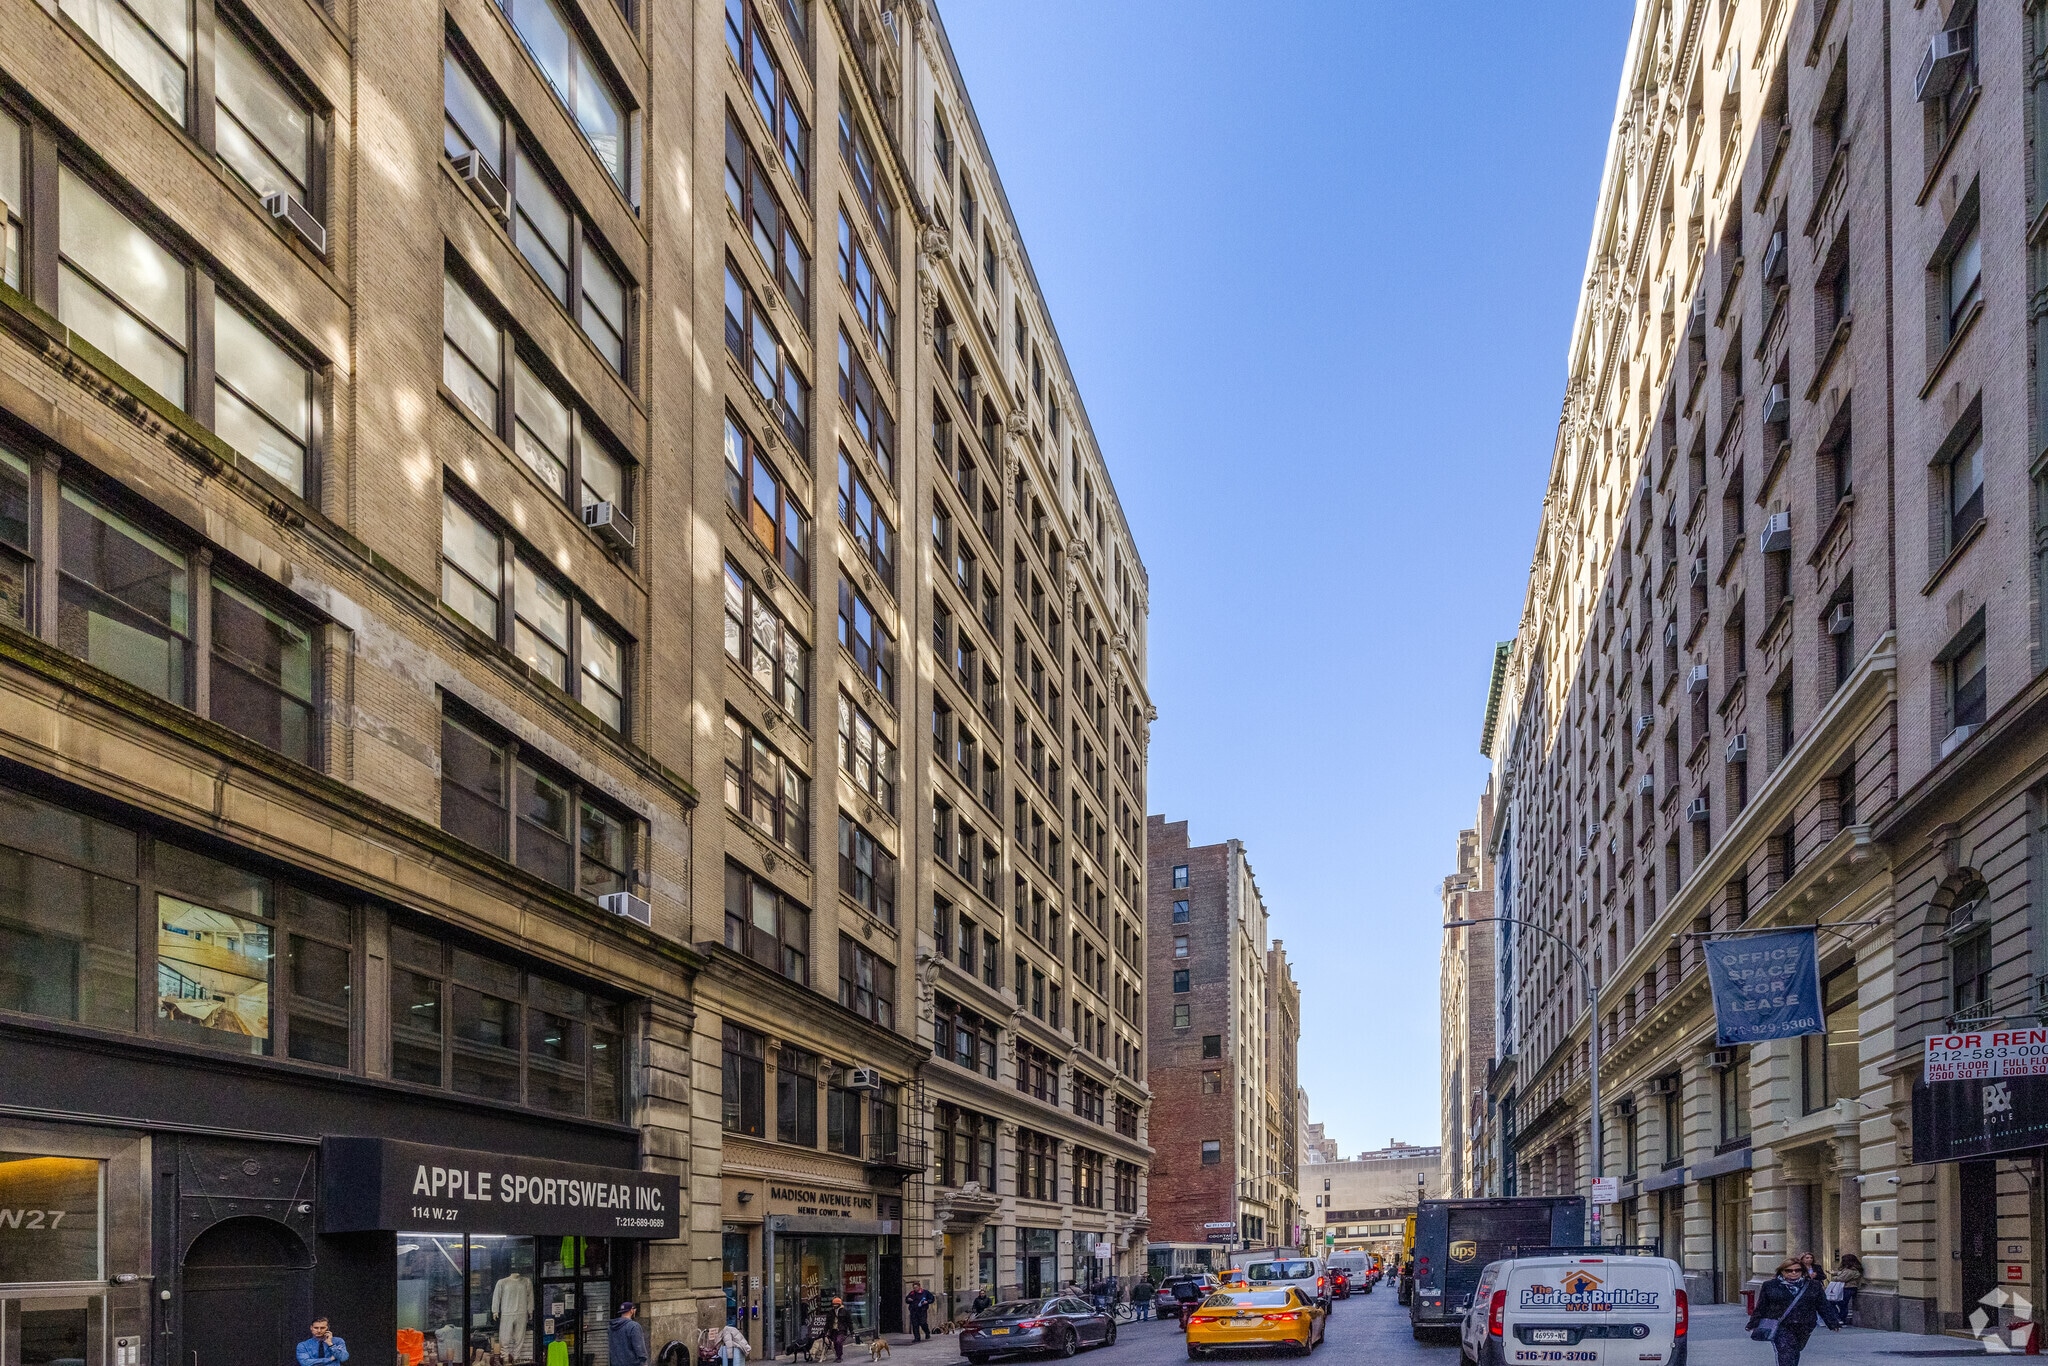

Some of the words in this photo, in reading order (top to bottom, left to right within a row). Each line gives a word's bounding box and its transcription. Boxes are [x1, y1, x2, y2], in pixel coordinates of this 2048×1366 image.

[1722, 946, 1800, 966] OFFICE
[1728, 962, 1797, 981] SPACE
[1742, 981, 1785, 996] FOR
[1731, 994, 1800, 1012] LEASE
[1929, 1035, 1982, 1051] FOR
[1929, 1064, 1954, 1072] HALF
[1957, 1061, 1989, 1070] FLOOR
[2003, 1058, 2027, 1067] FULL
[1929, 1071, 1954, 1080] 2500
[1958, 1070, 1972, 1078] SQ
[1977, 1069, 1989, 1077] FT
[2003, 1067, 2028, 1075] 5000
[2032, 1065, 2046, 1074] SQ
[1983, 1113, 2013, 1125] POLE
[413, 1165, 492, 1201] APPLE
[500, 1173, 631, 1209] SPORTSWEAR
[635, 1187, 665, 1211] INC.
[771, 1187, 817, 1204] MADISON
[818, 1193, 851, 1207] AVENUE
[853, 1197, 872, 1209] FURS
[411, 1206, 430, 1218] 114
[446, 1210, 458, 1220] 27
[797, 1206, 818, 1215] HENRY
[1451, 1246, 1475, 1259] ups
[844, 1263, 867, 1272] MOVING
[849, 1275, 862, 1285] SALE
[1531, 1285, 1553, 1294] The
[1521, 1288, 1590, 1305] Perfect
[1591, 1288, 1658, 1305] Builder
[1566, 1303, 1589, 1312] NYC
[1591, 1303, 1613, 1312] INC
[1516, 1351, 1597, 1362] 516-710-3706
